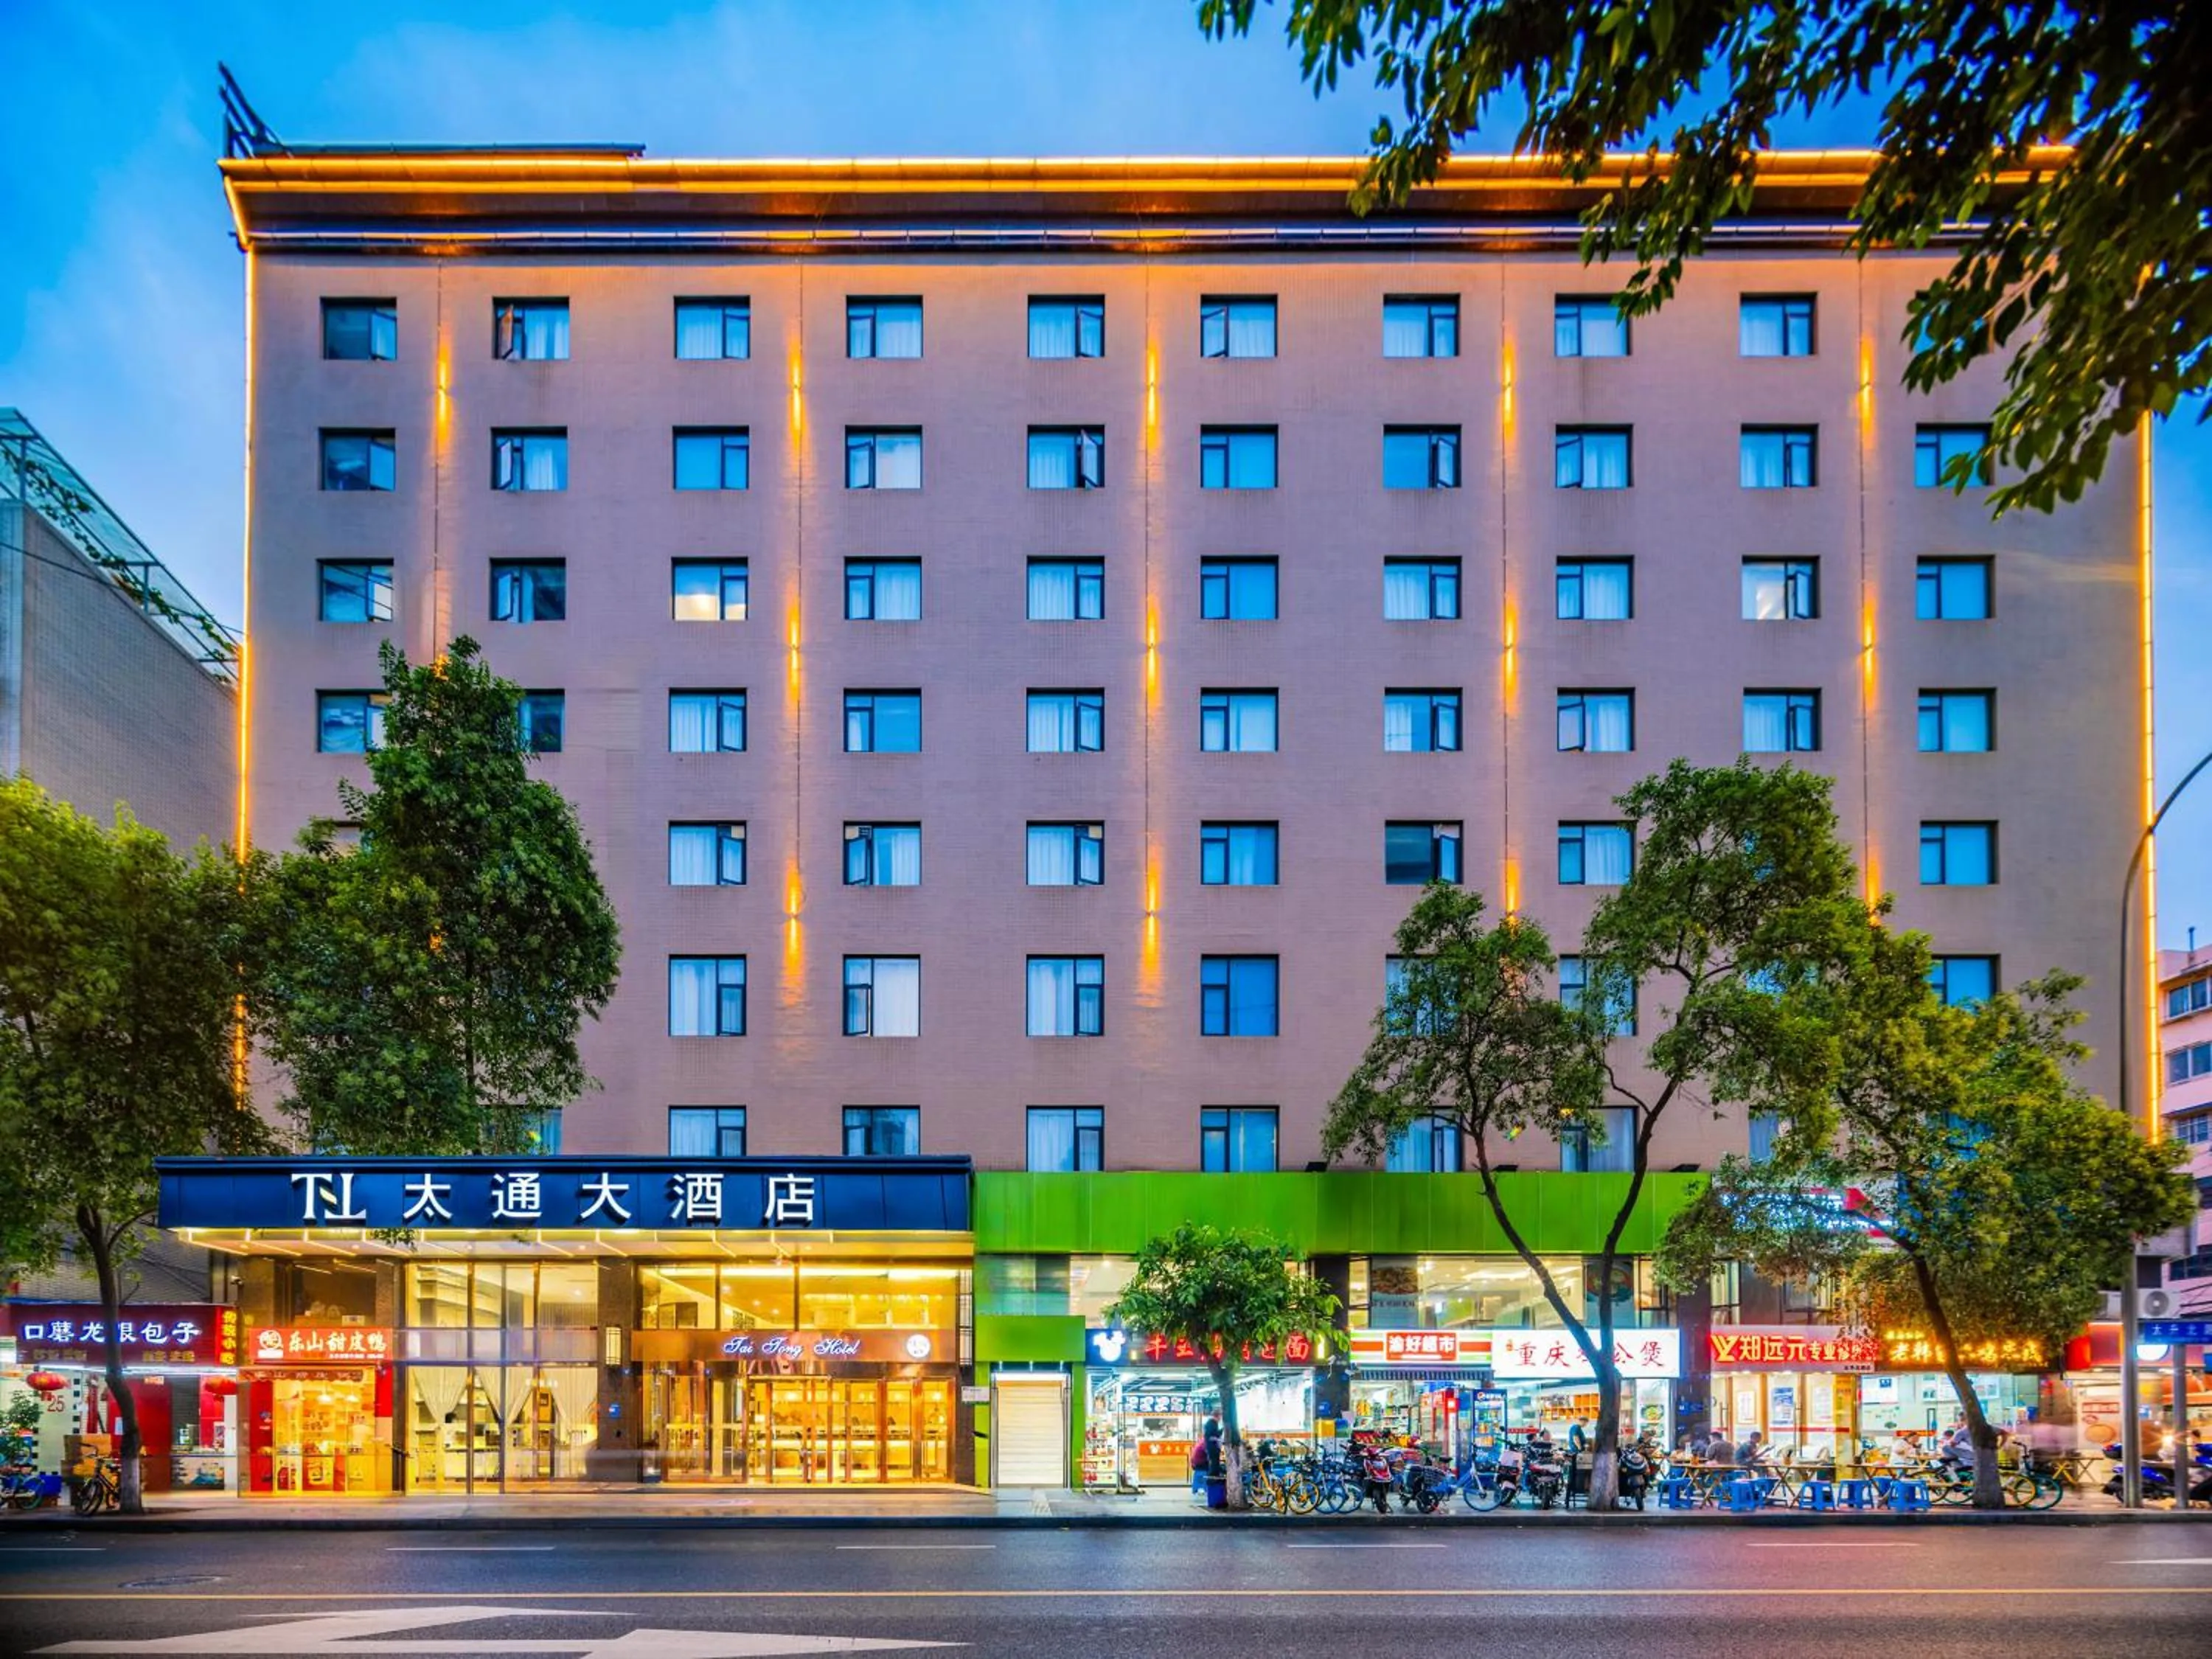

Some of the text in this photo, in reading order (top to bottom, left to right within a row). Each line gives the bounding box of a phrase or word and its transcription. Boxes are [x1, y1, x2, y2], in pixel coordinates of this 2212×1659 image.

[403, 1172, 815, 1221] 太通大酒店
[288, 1330, 388, 1353] 乐山甜皮鸭
[723, 1335, 862, 1359] Tai Tong Hotel
[1516, 1339, 1664, 1367] 重庆公煲
